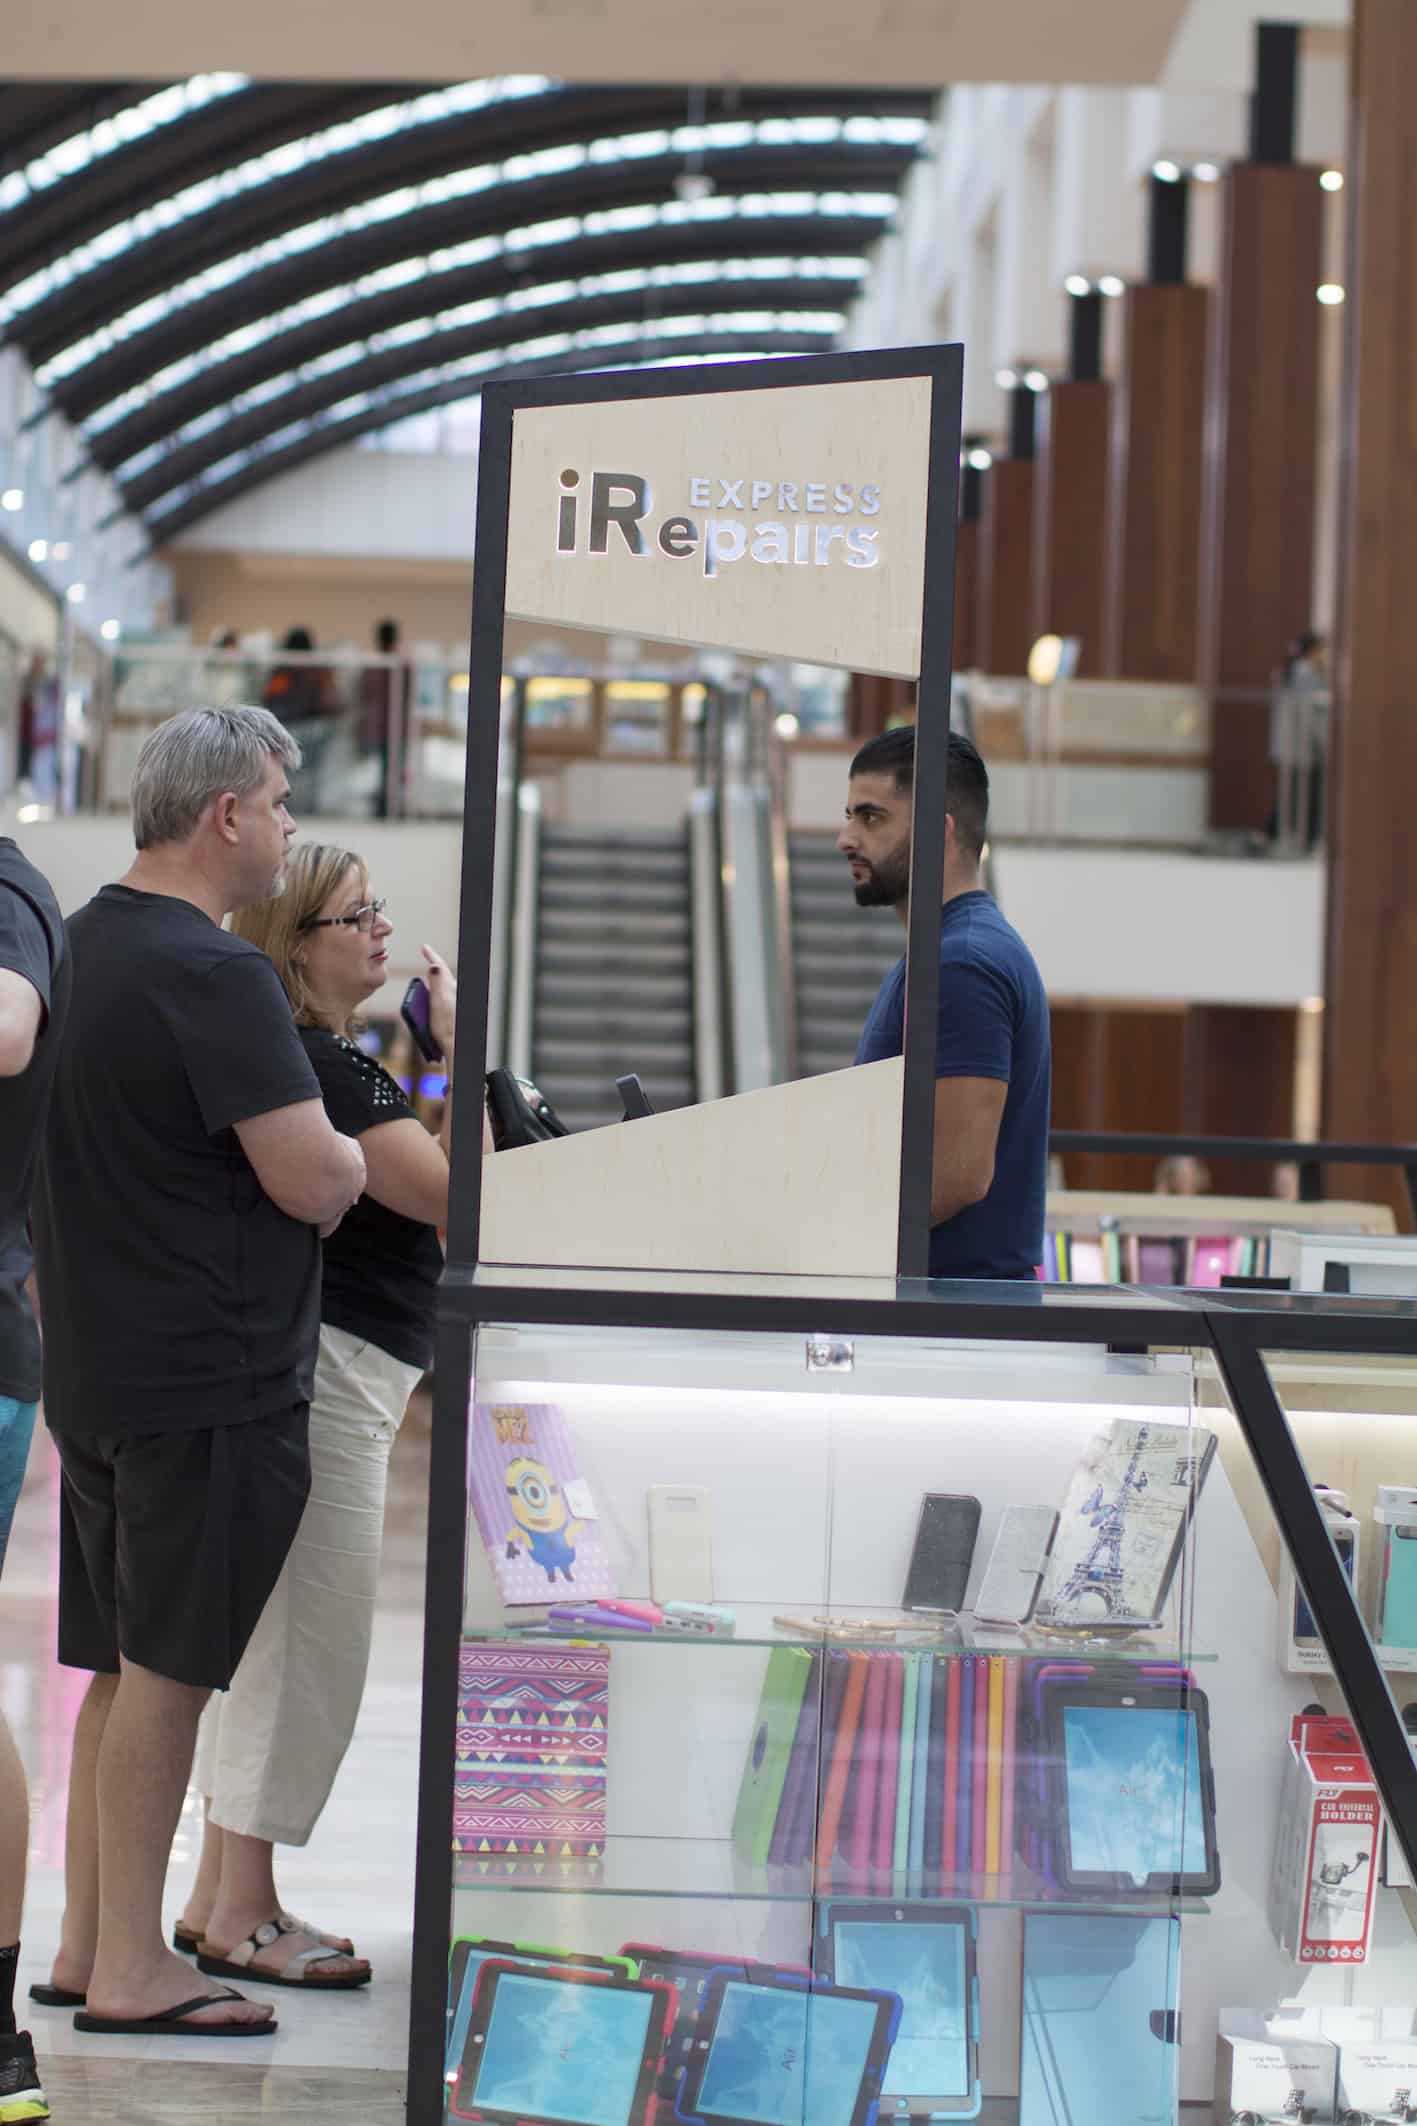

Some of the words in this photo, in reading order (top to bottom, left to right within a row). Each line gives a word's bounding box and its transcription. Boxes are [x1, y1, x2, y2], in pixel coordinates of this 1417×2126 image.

[689, 477, 881, 515] EXPRESS
[555, 467, 881, 578] iRepairs
[1320, 1811, 1373, 1821] HOLDER
